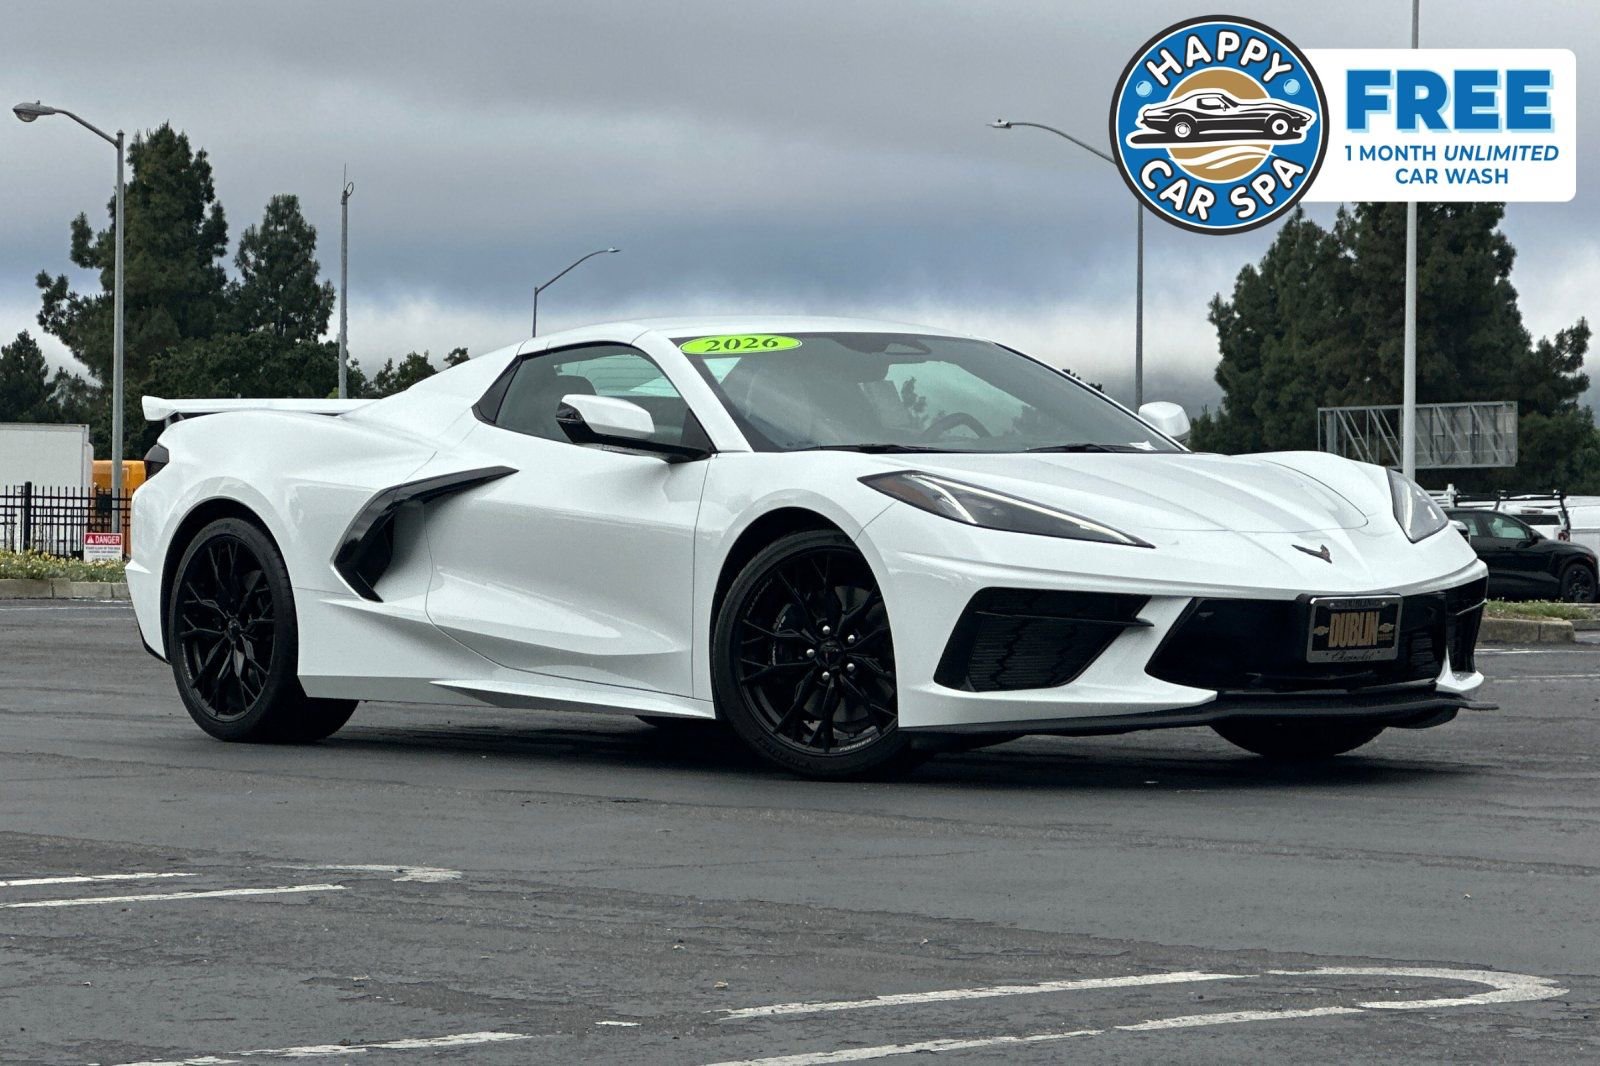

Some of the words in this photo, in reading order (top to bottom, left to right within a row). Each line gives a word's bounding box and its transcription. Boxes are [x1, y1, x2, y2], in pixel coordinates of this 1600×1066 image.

[704, 337, 779, 352] 2026
[95, 535, 120, 544] DANGER
[1328, 612, 1379, 647] DUBLIN
